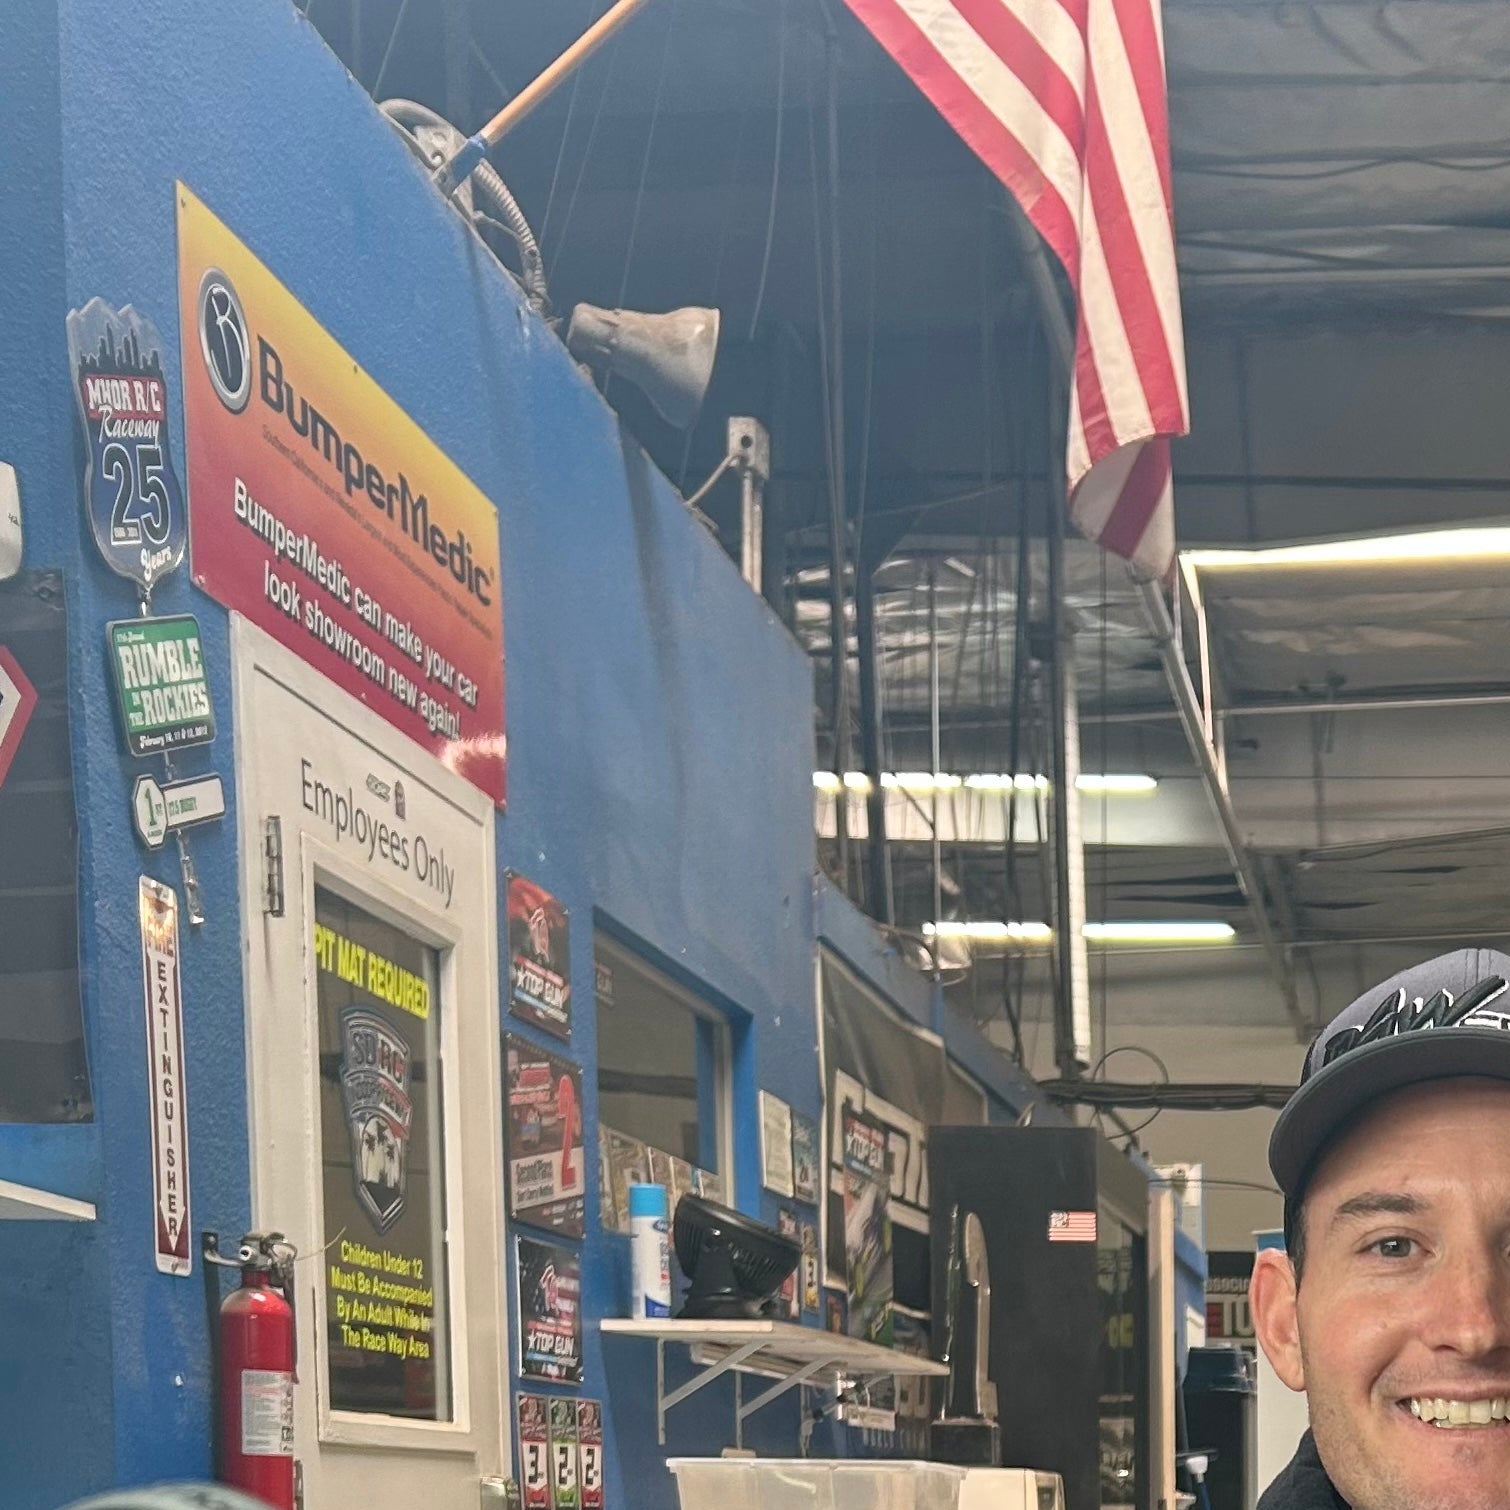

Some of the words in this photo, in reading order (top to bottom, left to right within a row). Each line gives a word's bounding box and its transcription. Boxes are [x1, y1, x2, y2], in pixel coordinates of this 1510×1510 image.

[133, 380, 162, 413] R/C
[98, 404, 160, 449] Raceway
[103, 443, 172, 545] 25
[257, 334, 492, 606] BumperMedic
[234, 477, 350, 604] BumperMedic
[355, 588, 382, 631] can
[386, 612, 423, 663] make
[425, 645, 455, 689] your
[458, 672, 479, 706] car
[119, 637, 204, 689] RUMBLE
[264, 560, 301, 620] look
[305, 599, 385, 684] showroom
[388, 667, 417, 708] new
[420, 690, 461, 740] again!
[140, 682, 210, 726] ROCKIES
[301, 757, 410, 871] Employees
[414, 835, 455, 910] Only
[314, 922, 336, 972] PIT
[337, 934, 367, 989] MAT
[367, 950, 430, 1020] REQUIRED
[155, 960, 180, 1237] EXTINGUISHER
[341, 1240, 381, 1269] Children
[383, 1250, 411, 1276] Under
[412, 1258, 423, 1280] 12
[331, 1265, 357, 1291] Must
[357, 1271, 371, 1295] Be
[372, 1275, 433, 1308] Accompanied
[336, 1294, 351, 1322] By
[352, 1298, 367, 1321] An
[367, 1301, 393, 1327] Adult
[393, 1305, 419, 1332] While
[341, 1324, 361, 1348] The
[362, 1327, 387, 1352] Race
[387, 1331, 408, 1360] Way
[408, 1335, 430, 1359] Area
[536, 1331, 554, 1352] TOP
